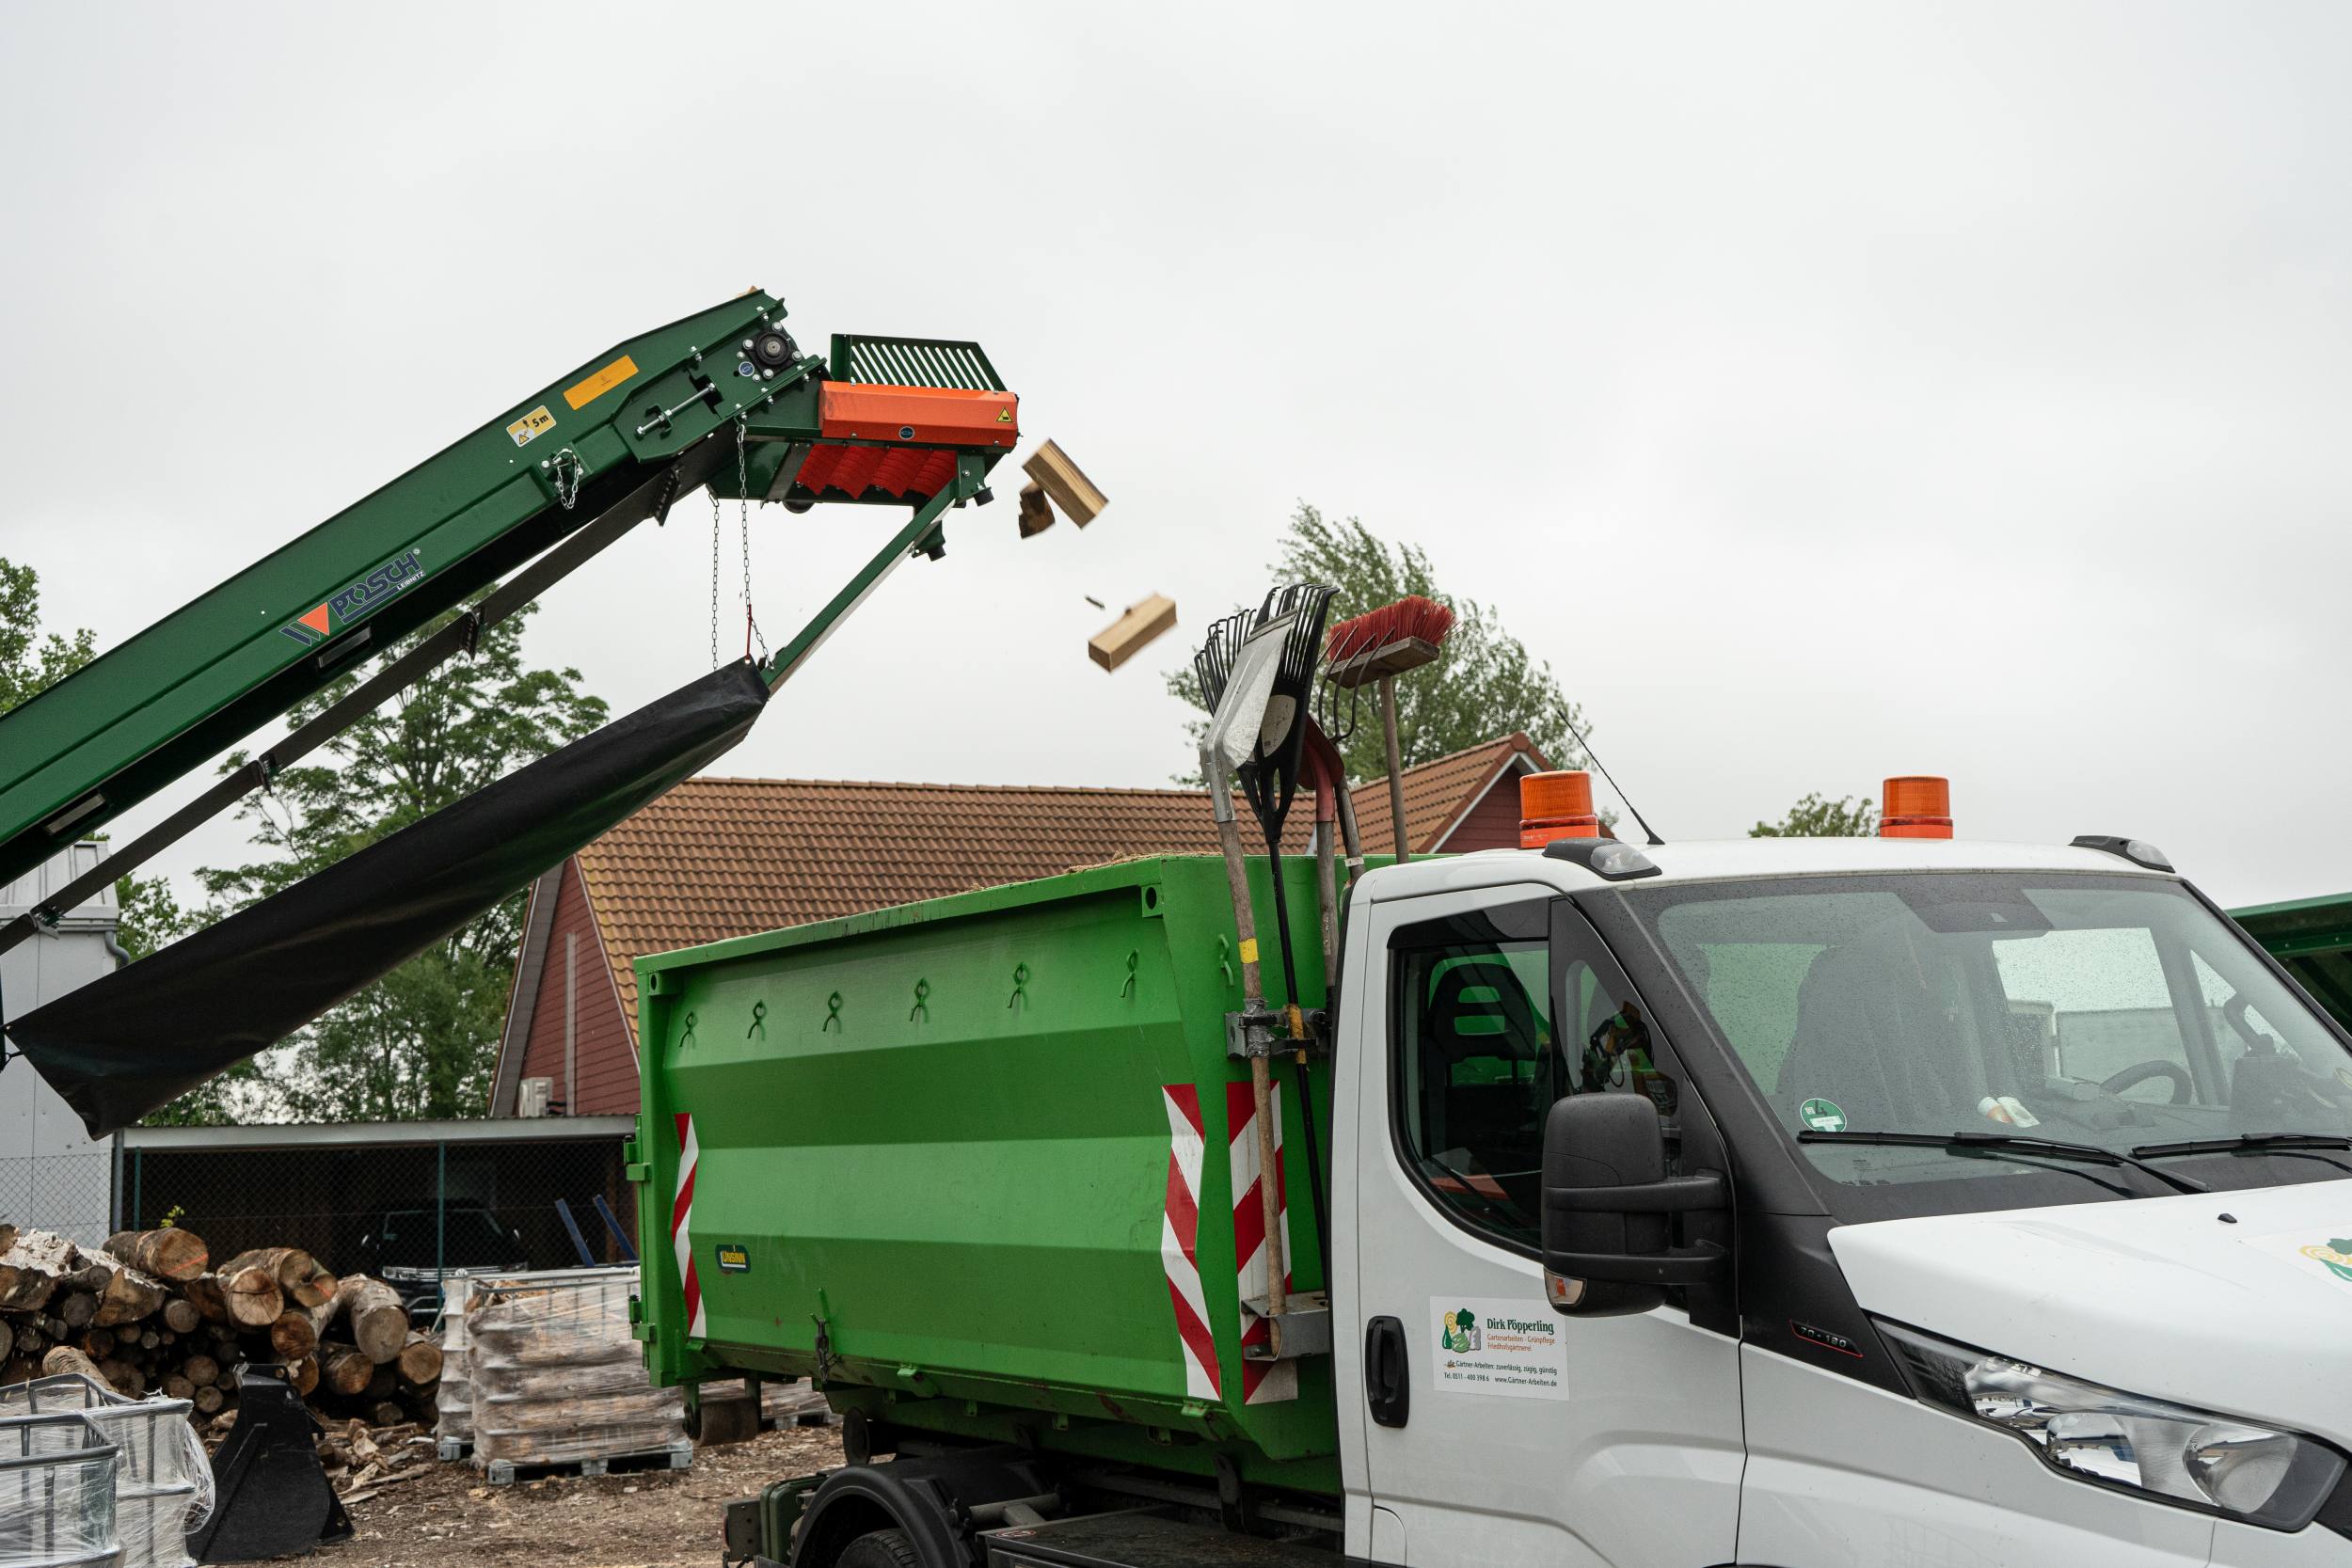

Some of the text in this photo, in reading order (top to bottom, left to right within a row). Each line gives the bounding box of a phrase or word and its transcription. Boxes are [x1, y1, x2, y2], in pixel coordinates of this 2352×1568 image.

[532, 415, 548, 427] 5 m
[328, 551, 421, 619] POSCH
[1486, 1318, 1554, 1336] Dirk Pöpperling
[1487, 1334, 1556, 1345] Gartenarbeiten Grünpflege
